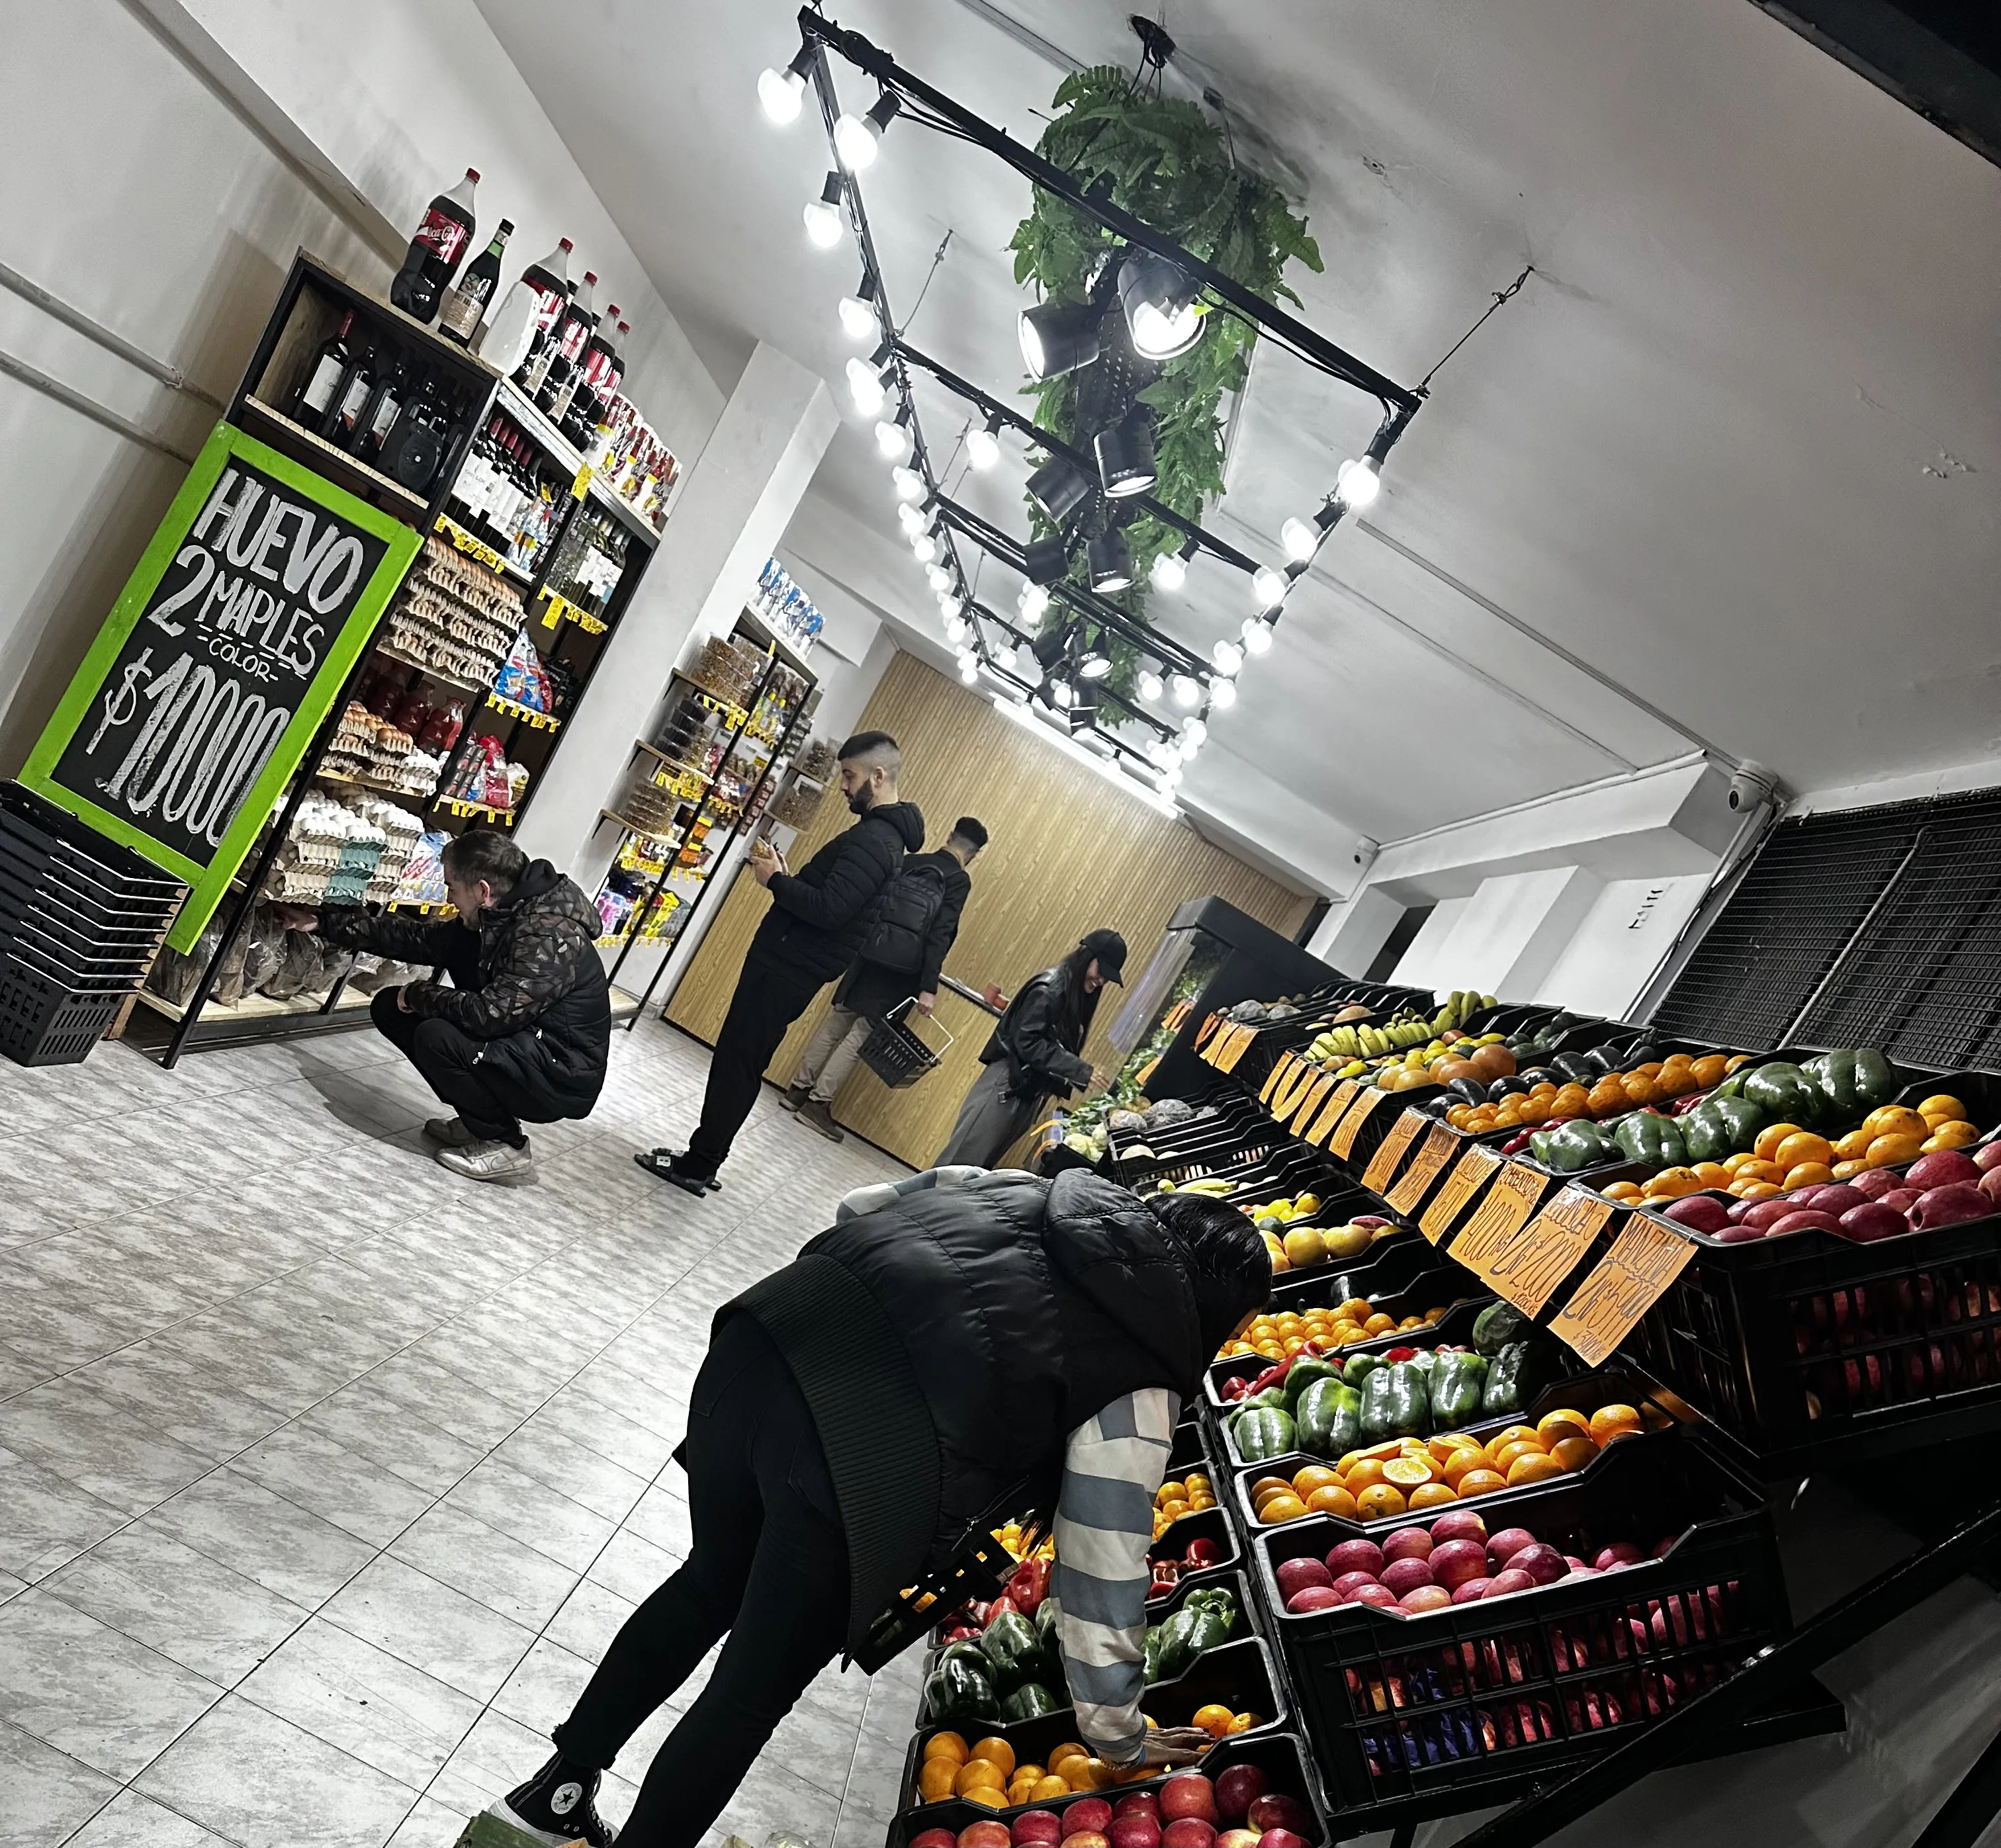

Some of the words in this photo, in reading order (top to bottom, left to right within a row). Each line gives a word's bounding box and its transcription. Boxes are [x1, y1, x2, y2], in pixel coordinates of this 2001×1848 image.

[193, 467, 365, 615] HUEVO
[148, 545, 216, 637] 2
[195, 570, 326, 675] MAPLES
[1609, 1214, 1686, 1288] MANZANA
